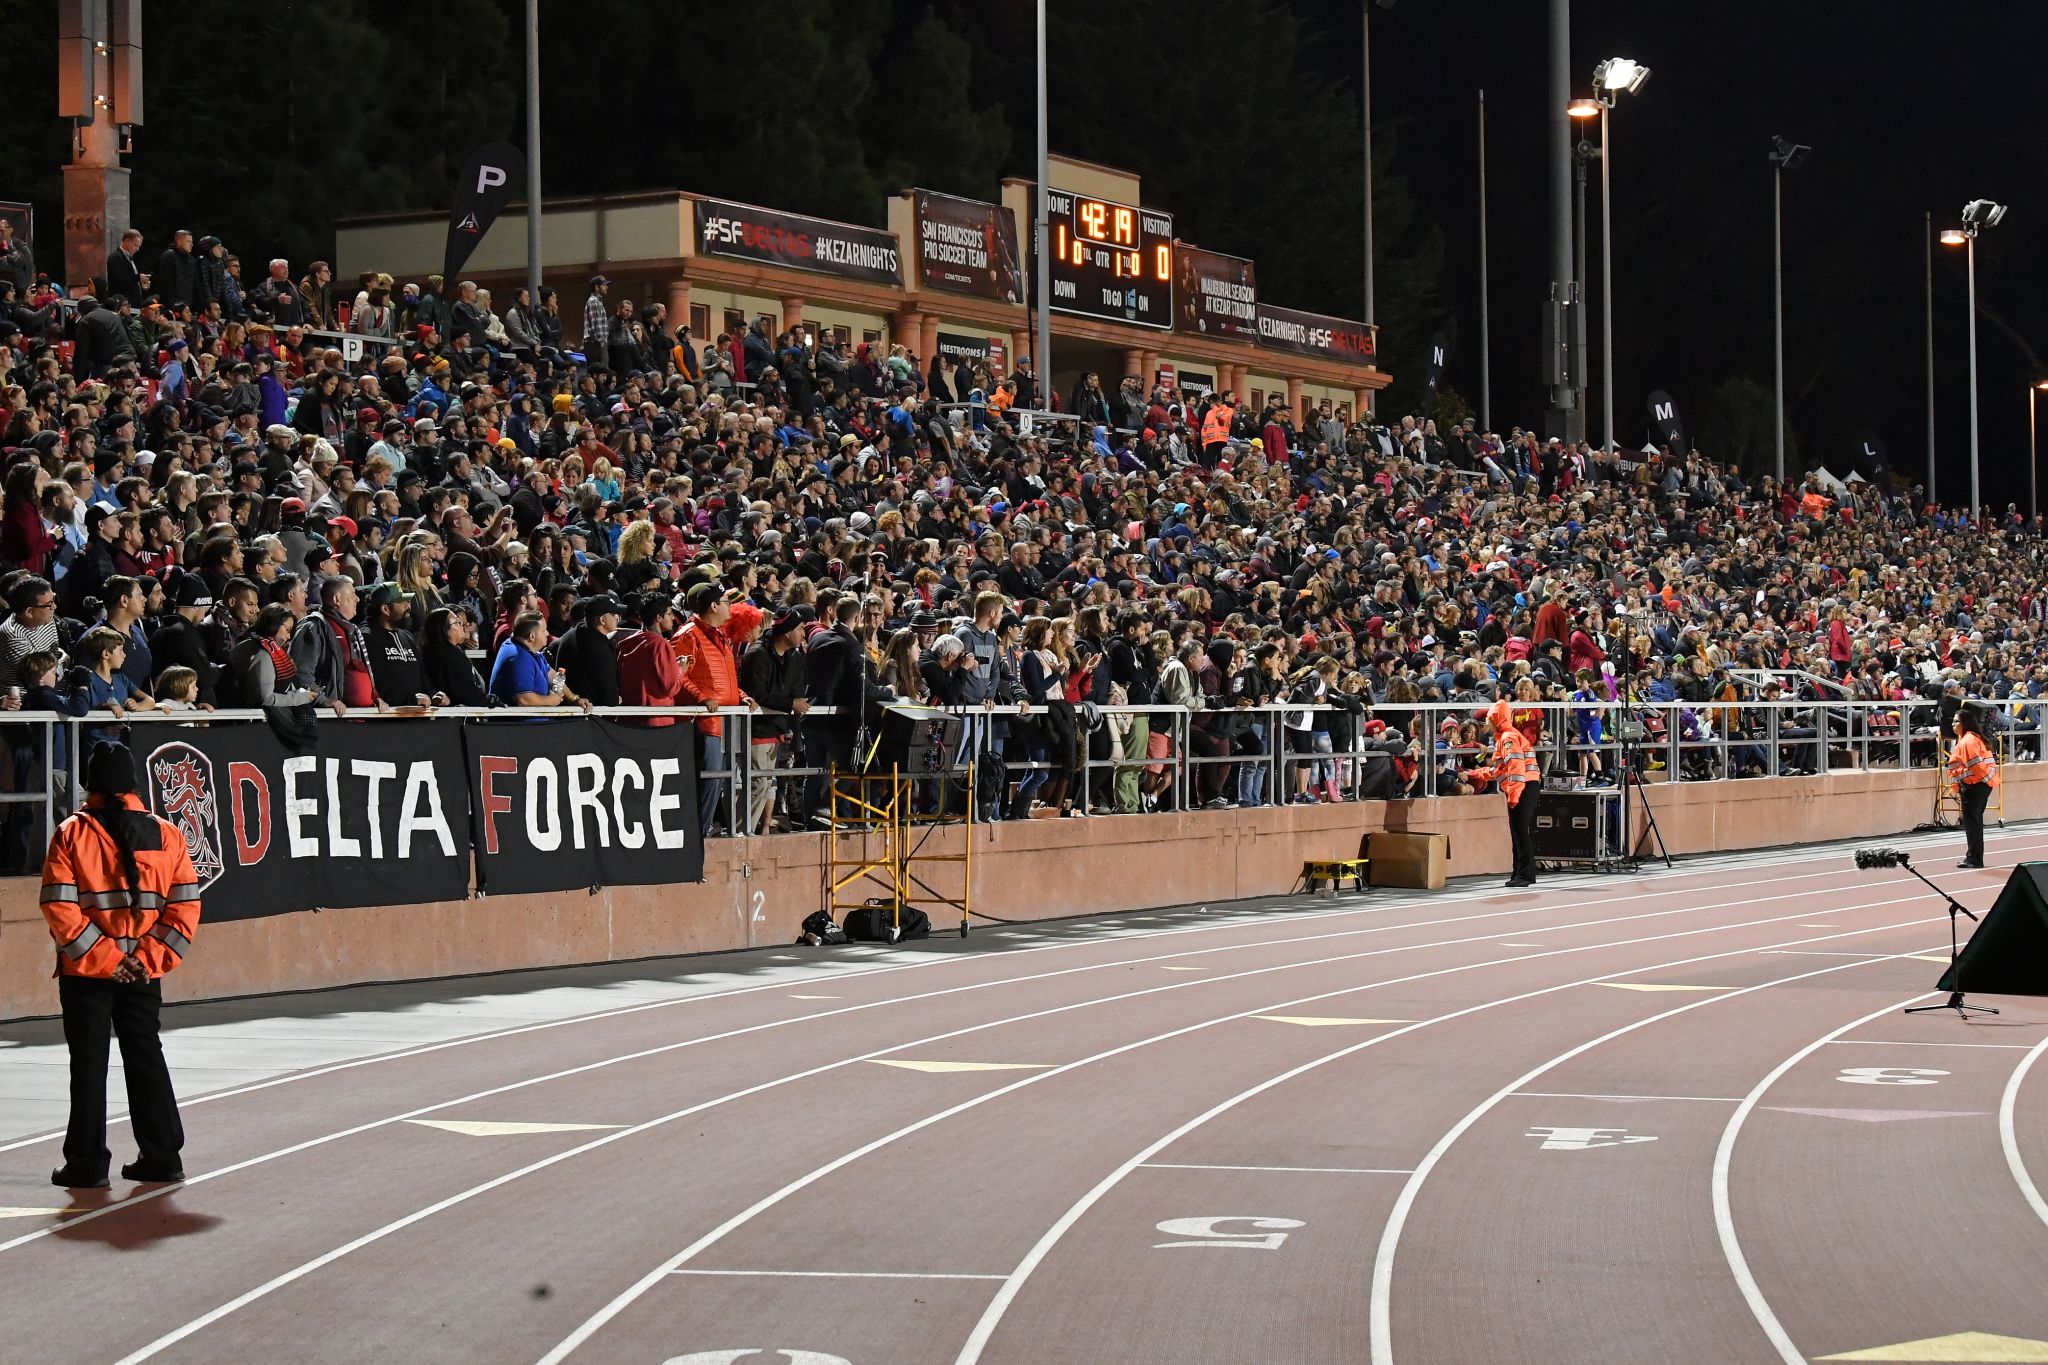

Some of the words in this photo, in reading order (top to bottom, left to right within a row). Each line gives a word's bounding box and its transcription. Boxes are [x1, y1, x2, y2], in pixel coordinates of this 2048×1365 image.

[477, 165, 507, 194] P
[922, 220, 937, 240] SAN
[938, 223, 983, 249] FRANCISCO'S
[1143, 216, 1170, 237] VISITOR
[1059, 225, 1065, 260] 1
[816, 237, 897, 272] #KEZARNIGHTS
[924, 240, 938, 260] PRO
[938, 243, 967, 265] SOCCER
[967, 248, 988, 269] TEAM
[1157, 246, 1169, 280] 0
[1054, 280, 1076, 299] DOWN
[1102, 288, 1112, 305] TO
[1112, 290, 1122, 308] GO
[1231, 283, 1255, 303] SEASON
[1138, 295, 1149, 312] ON
[1205, 295, 1213, 312] AT
[1212, 297, 1231, 316] KEZAR
[1231, 301, 1256, 321] STADIUM
[349, 341, 358, 359] P
[943, 343, 981, 358] RESTROOMS
[1433, 345, 1444, 367] N
[1182, 381, 1209, 392] RESTROOMS
[1655, 402, 1674, 421] M
[1863, 442, 1876, 456] L
[228, 755, 457, 866] DELTA
[479, 753, 685, 855] FORCE
[753, 890, 766, 922] 2
[1835, 1067, 1952, 1086] 3
[1524, 1126, 1659, 1151] 4
[1150, 1215, 1307, 1251] 5
